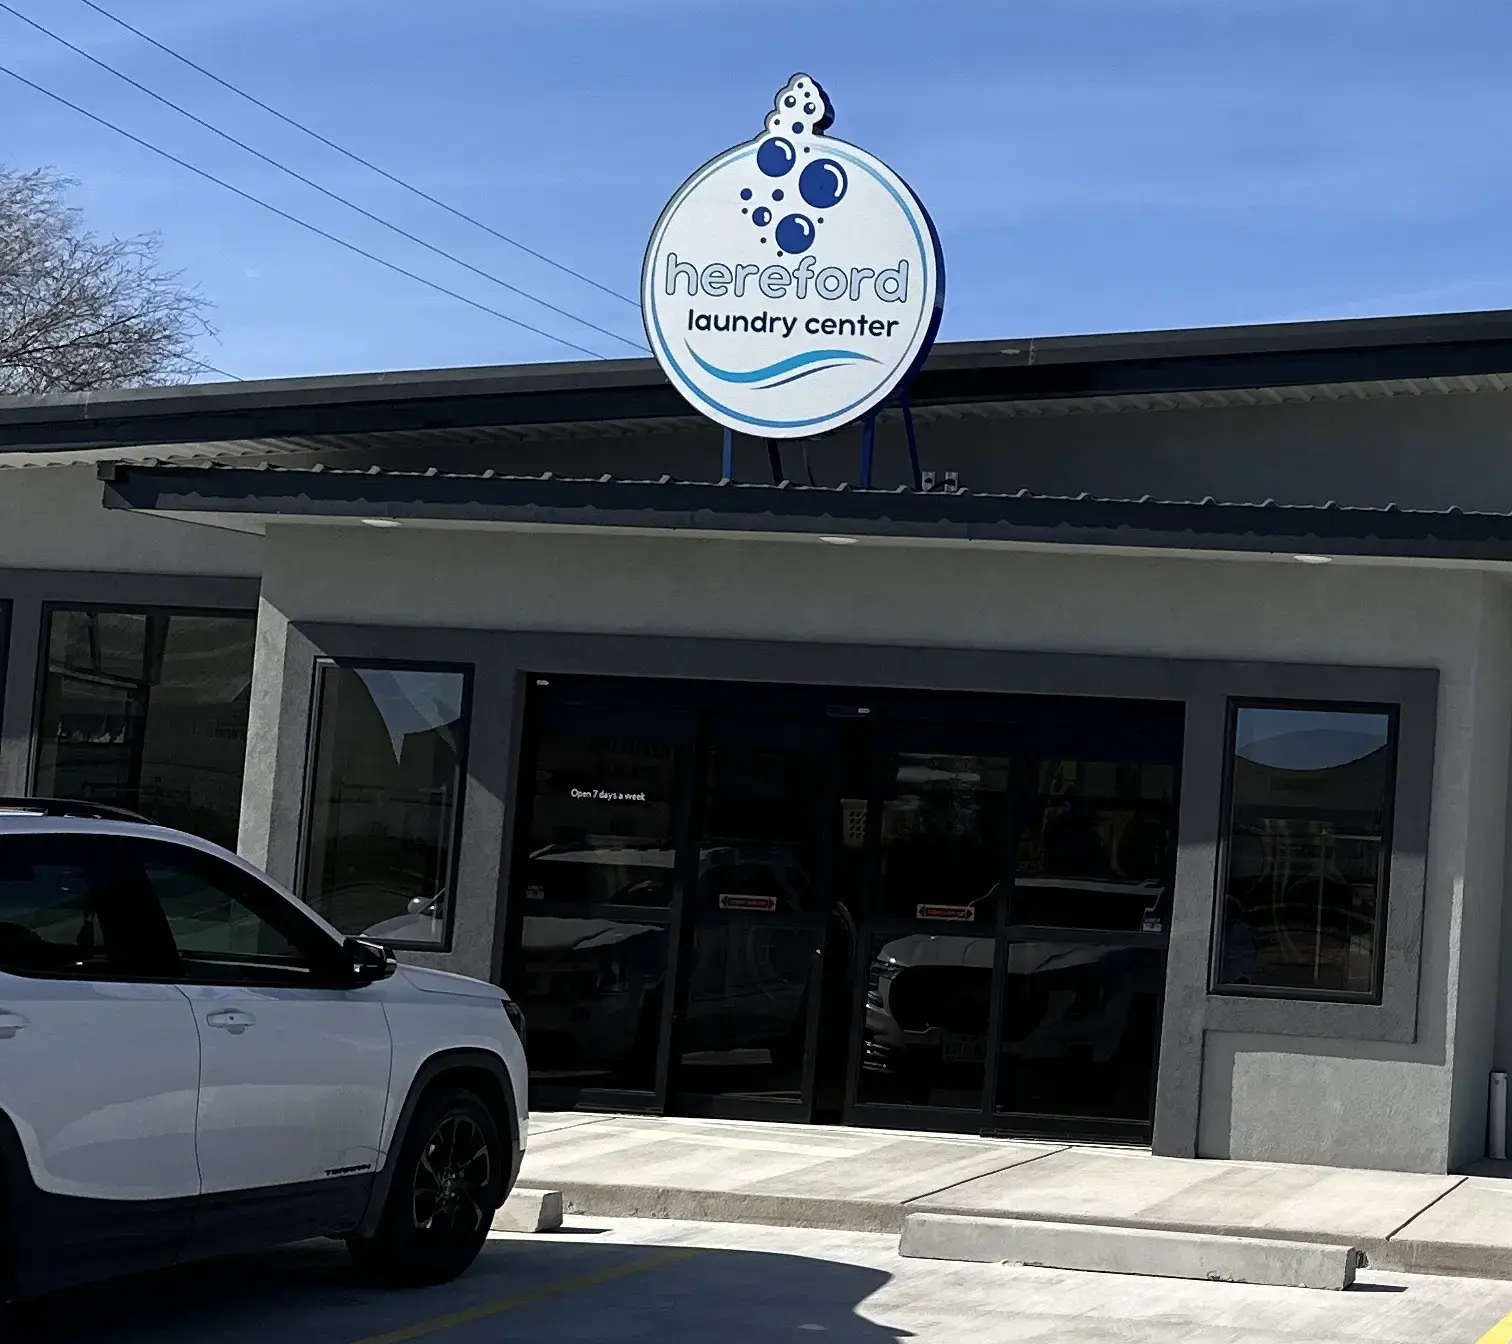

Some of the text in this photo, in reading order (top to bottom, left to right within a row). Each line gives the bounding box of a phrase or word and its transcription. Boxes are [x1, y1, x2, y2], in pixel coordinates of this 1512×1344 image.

[665, 253, 909, 303] hereford
[687, 309, 899, 338] laundry center
[571, 788, 591, 799] Open
[593, 789, 598, 798] 7
[599, 790, 617, 801] days
[625, 792, 646, 801] week
